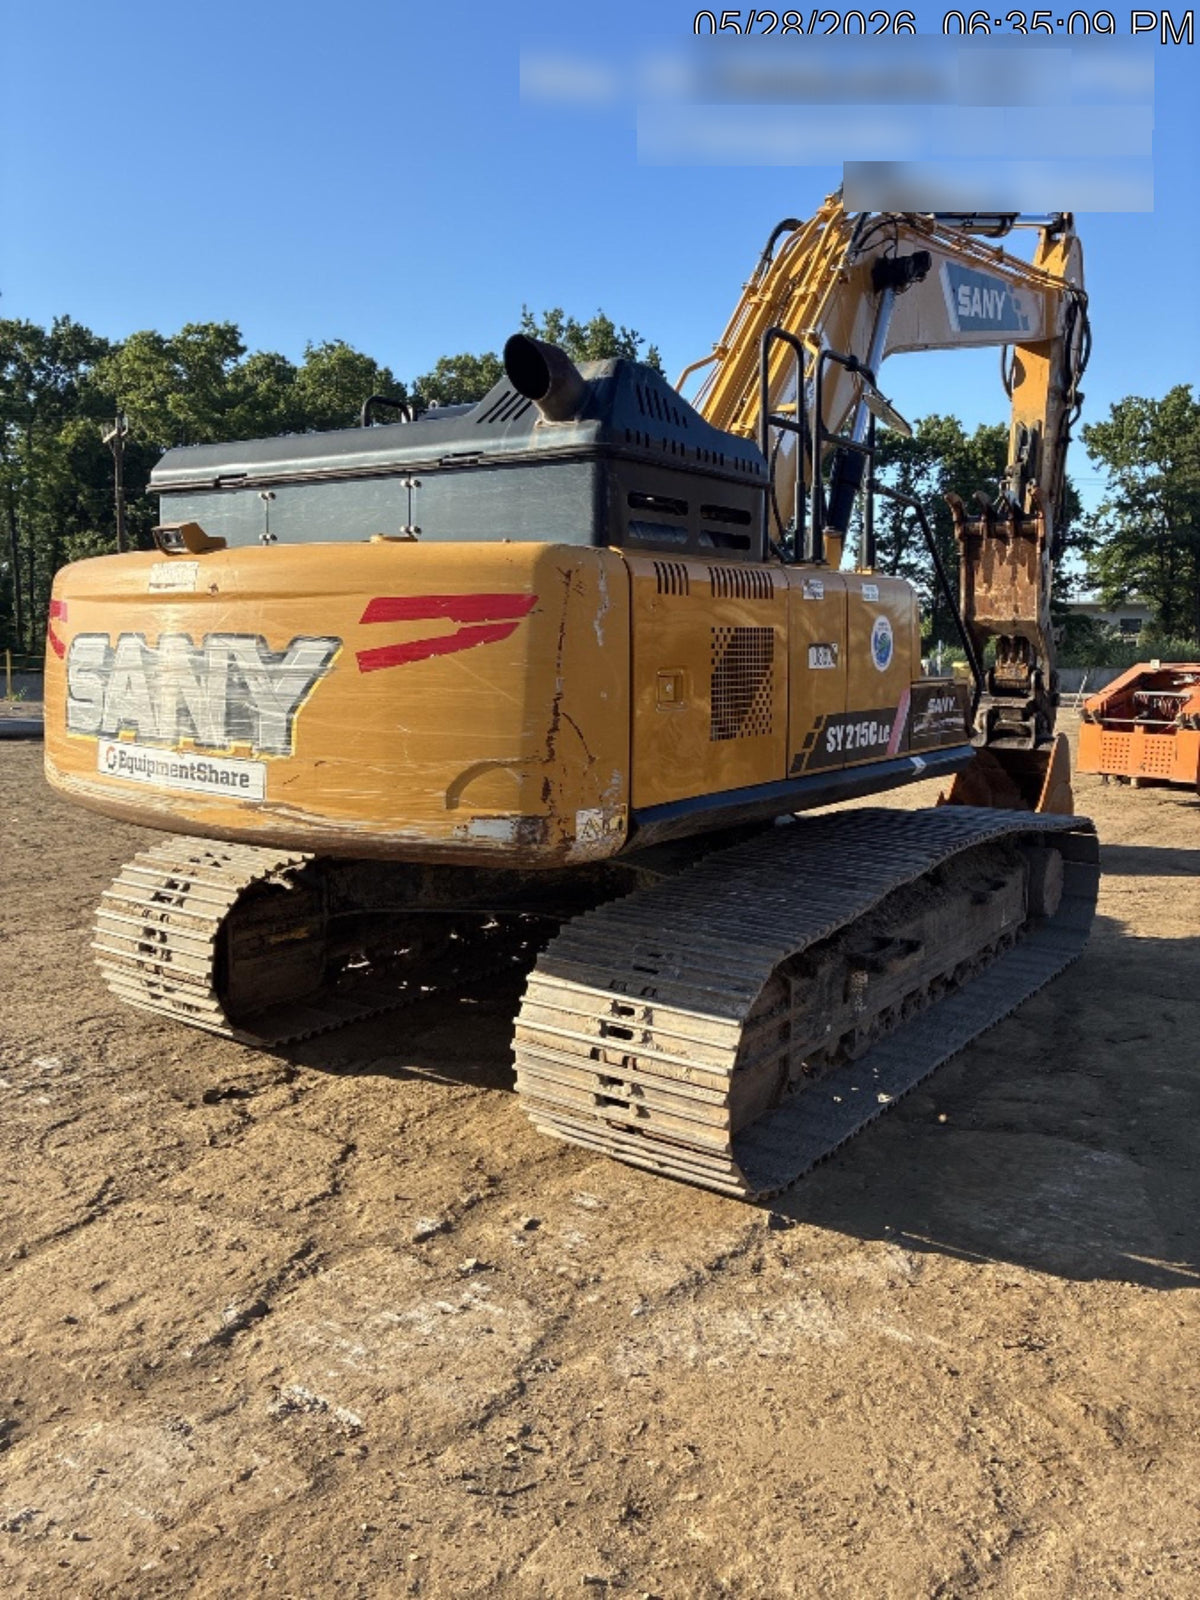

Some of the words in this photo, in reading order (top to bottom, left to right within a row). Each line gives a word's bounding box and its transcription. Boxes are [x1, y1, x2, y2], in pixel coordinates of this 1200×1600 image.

[957, 284, 1006, 321] SANY
[67, 633, 341, 755] SANY
[118, 750, 250, 788] EquipmentShare
